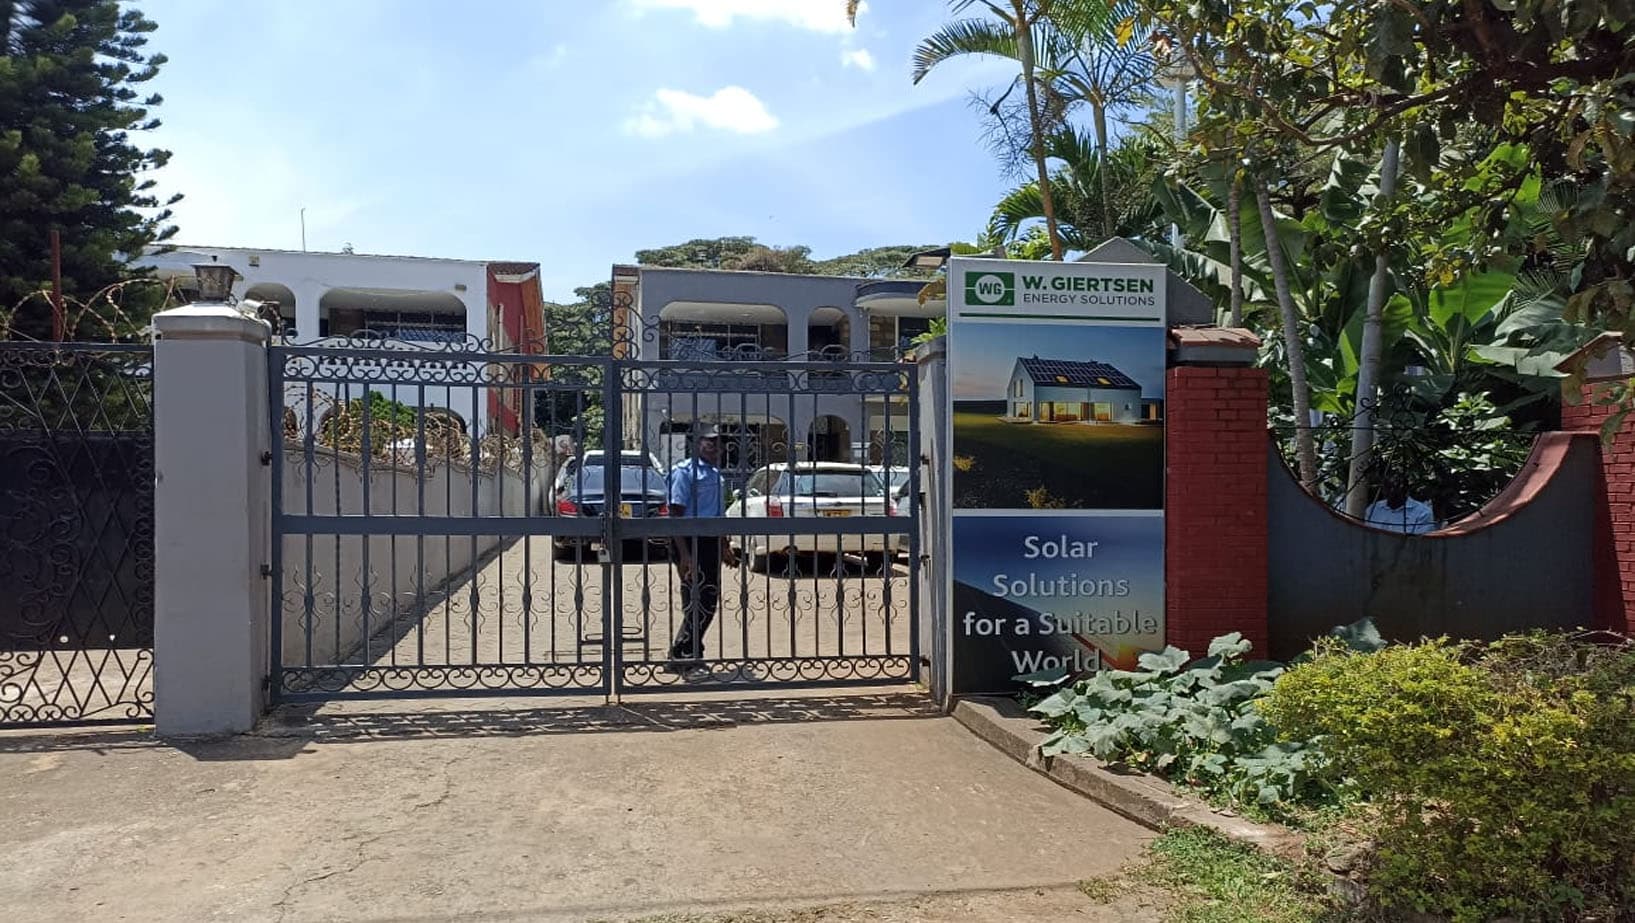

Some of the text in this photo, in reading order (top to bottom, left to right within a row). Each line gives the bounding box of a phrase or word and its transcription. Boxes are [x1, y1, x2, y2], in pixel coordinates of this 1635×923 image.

[979, 282, 1002, 295] WG
[1022, 276, 1154, 293] W. GIERTSEN
[1023, 293, 1155, 306] ENERGY SOLUTIONS
[1024, 535, 1098, 558] Solar
[993, 573, 1129, 597] Solutions
[963, 611, 1158, 635] for a Suitable
[1011, 649, 1101, 673] World
